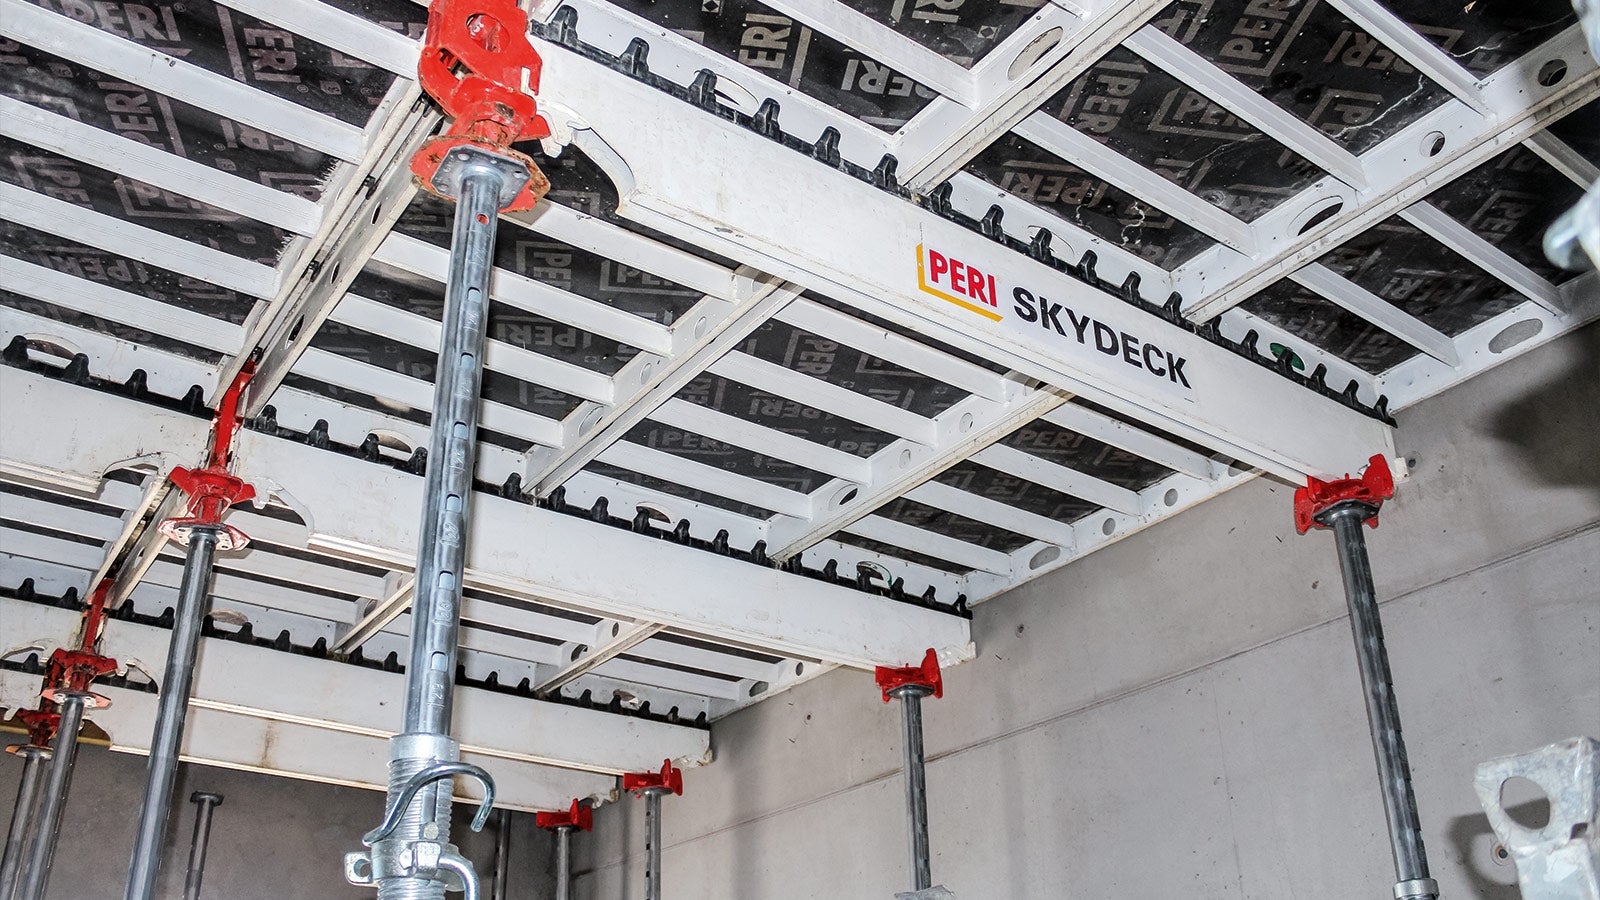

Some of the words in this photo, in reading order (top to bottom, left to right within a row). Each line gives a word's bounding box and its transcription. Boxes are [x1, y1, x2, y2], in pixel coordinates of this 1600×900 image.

[244, 21, 302, 84] ERI
[738, 12, 793, 70] ERI
[495, 322, 577, 348] PERI
[929, 248, 997, 308] PERI
[1013, 286, 1192, 389] SKYDECK
[1015, 429, 1084, 448] PERI
